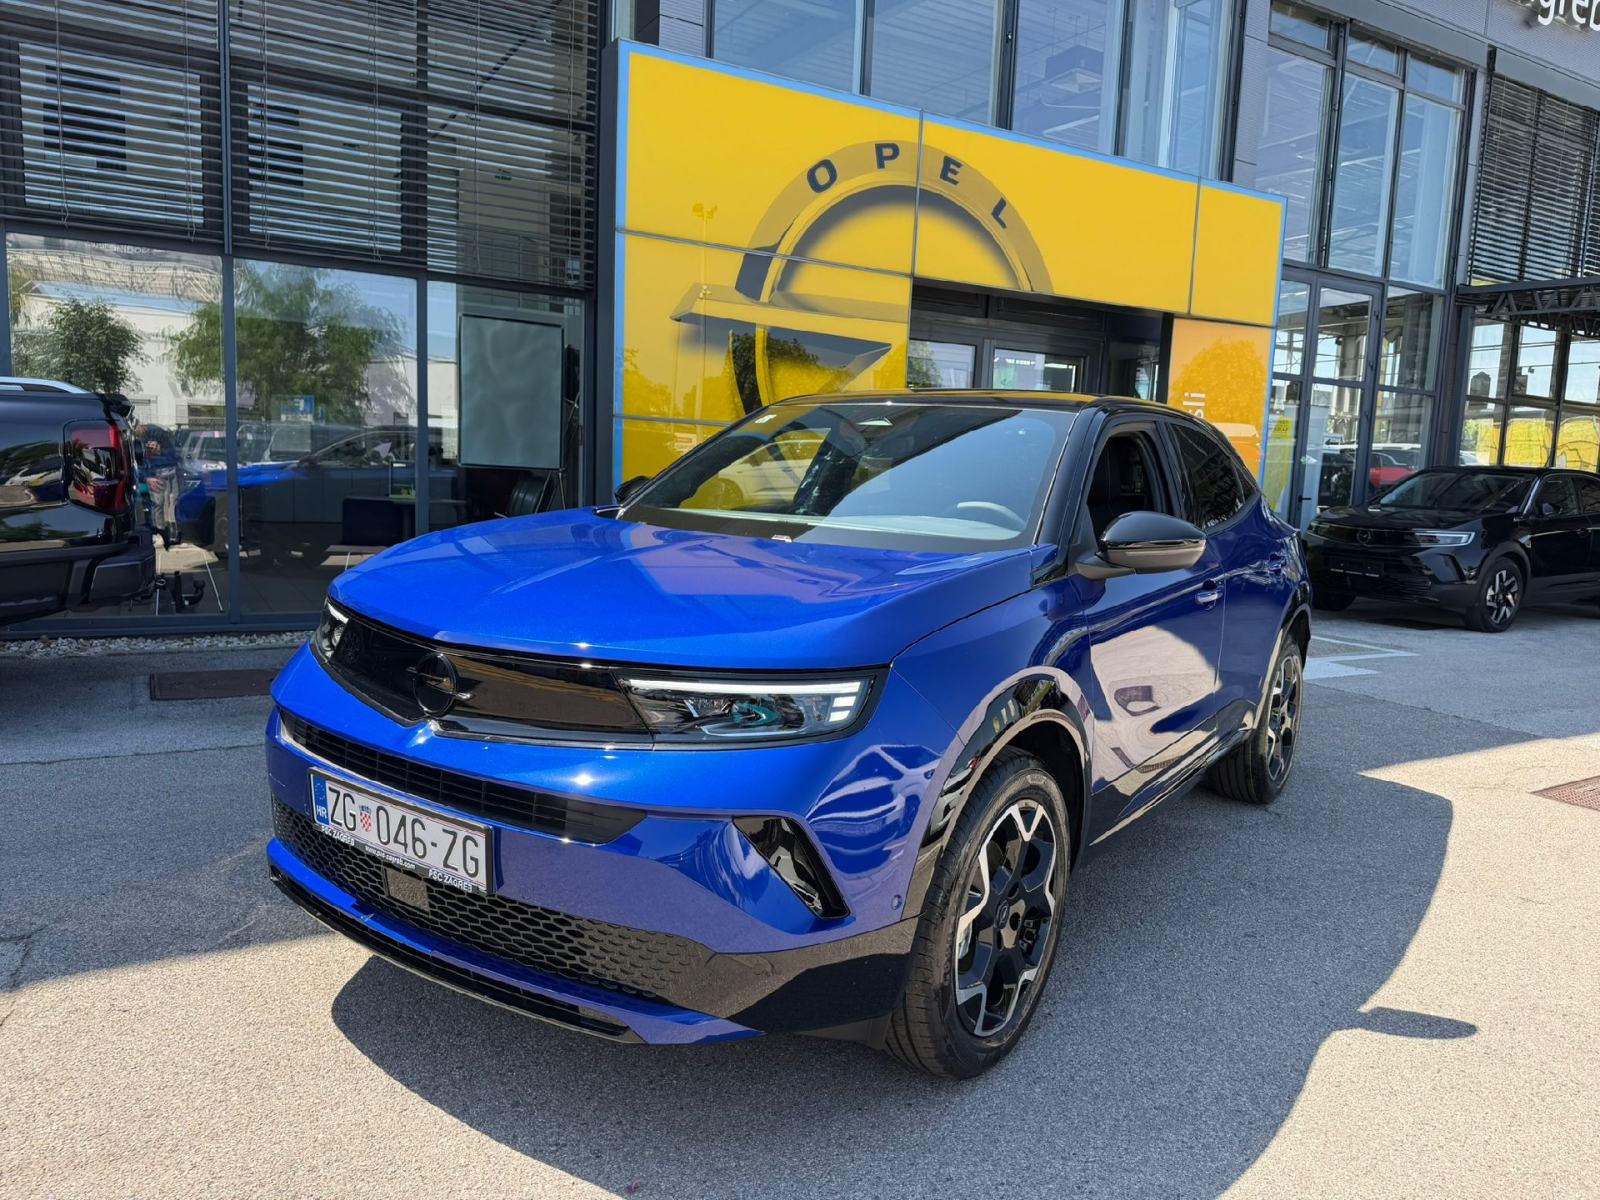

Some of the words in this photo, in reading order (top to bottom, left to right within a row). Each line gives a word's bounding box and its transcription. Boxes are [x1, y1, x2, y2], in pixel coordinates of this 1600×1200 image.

[806, 142, 1007, 229] OPEL
[316, 804, 328, 819] HR
[328, 786, 357, 832] ZG
[376, 805, 480, 878] 046-ZG
[428, 869, 443, 882] PSC
[443, 875, 473, 893] ZAGREB
